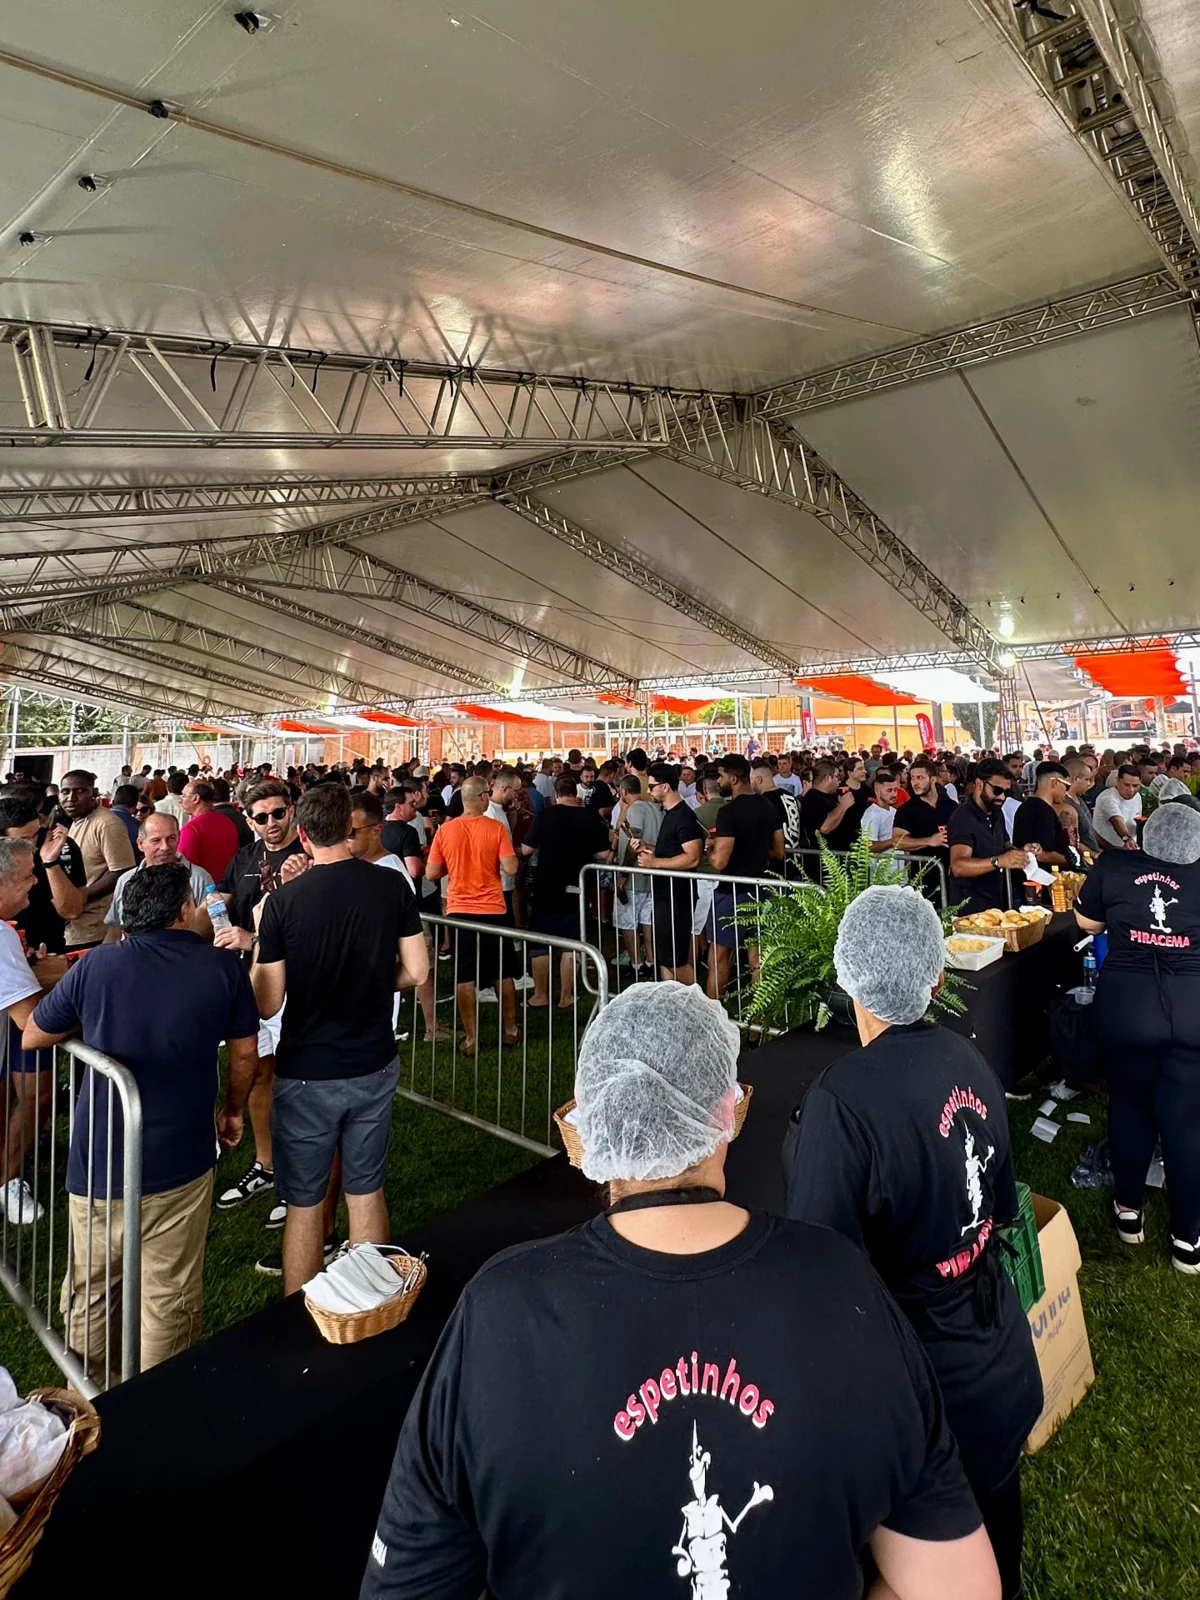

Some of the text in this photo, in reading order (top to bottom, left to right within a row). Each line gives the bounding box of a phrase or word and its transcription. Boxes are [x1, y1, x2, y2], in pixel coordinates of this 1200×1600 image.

[1134, 872, 1181, 890] espetinhos
[1130, 929, 1191, 948] PIRACEMA
[938, 1085, 988, 1138] espetinhos
[614, 1350, 774, 1441] espetinhos
